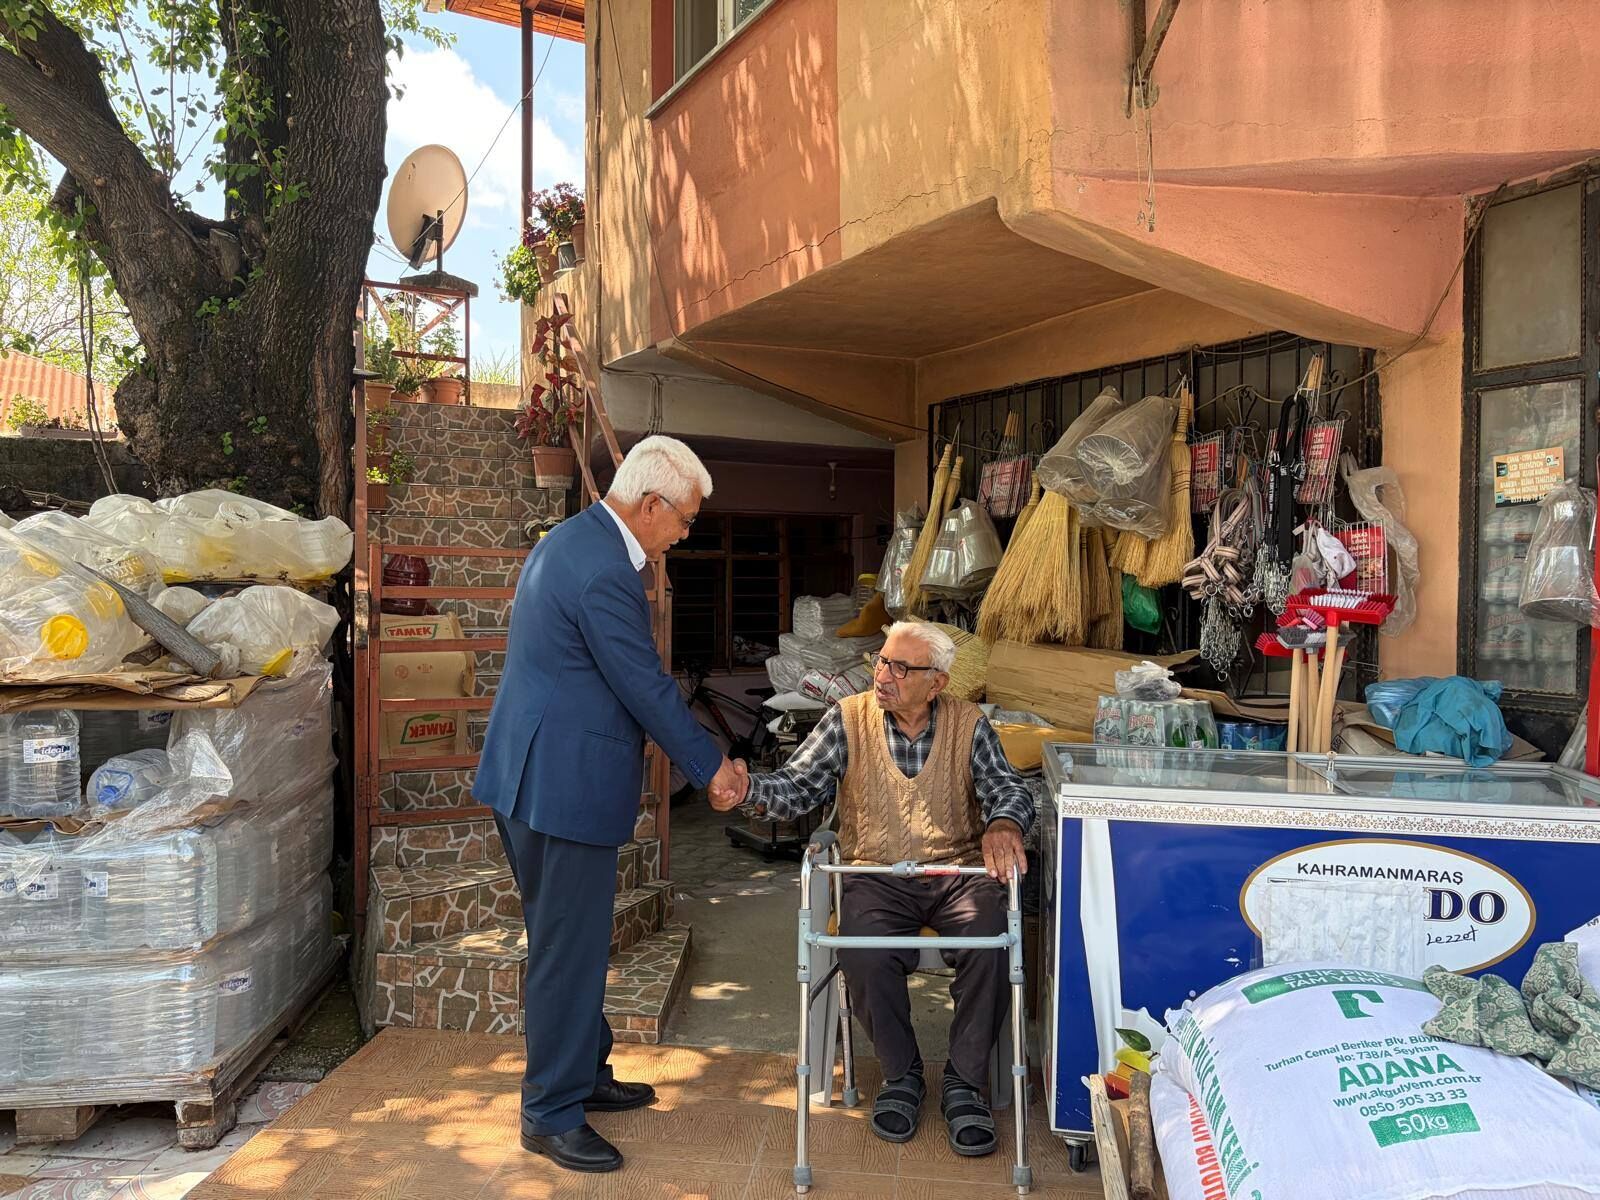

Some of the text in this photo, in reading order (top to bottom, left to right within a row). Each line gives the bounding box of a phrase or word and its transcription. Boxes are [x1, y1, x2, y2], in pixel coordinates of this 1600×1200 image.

[388, 626, 432, 637] TAMEK
[409, 721, 456, 738] TAMEK
[41, 745, 64, 755] ideal
[1297, 862, 1464, 885] KAHRAMANMARAŞ
[1423, 886, 1508, 925] DO
[1284, 976, 1326, 989] TAM
[1264, 1053, 1304, 1073] Turhan
[1304, 1043, 1340, 1060] Cemal
[1341, 1038, 1384, 1052] Beriker
[1335, 1044, 1440, 1064] No: 738/A Seyhan
[1338, 1053, 1465, 1093] ADANA
[1332, 1074, 1483, 1108] www.akgulyem.com.tr
[1359, 1087, 1468, 1118] 0850 305 33 33
[1395, 1112, 1449, 1136] 50kg
